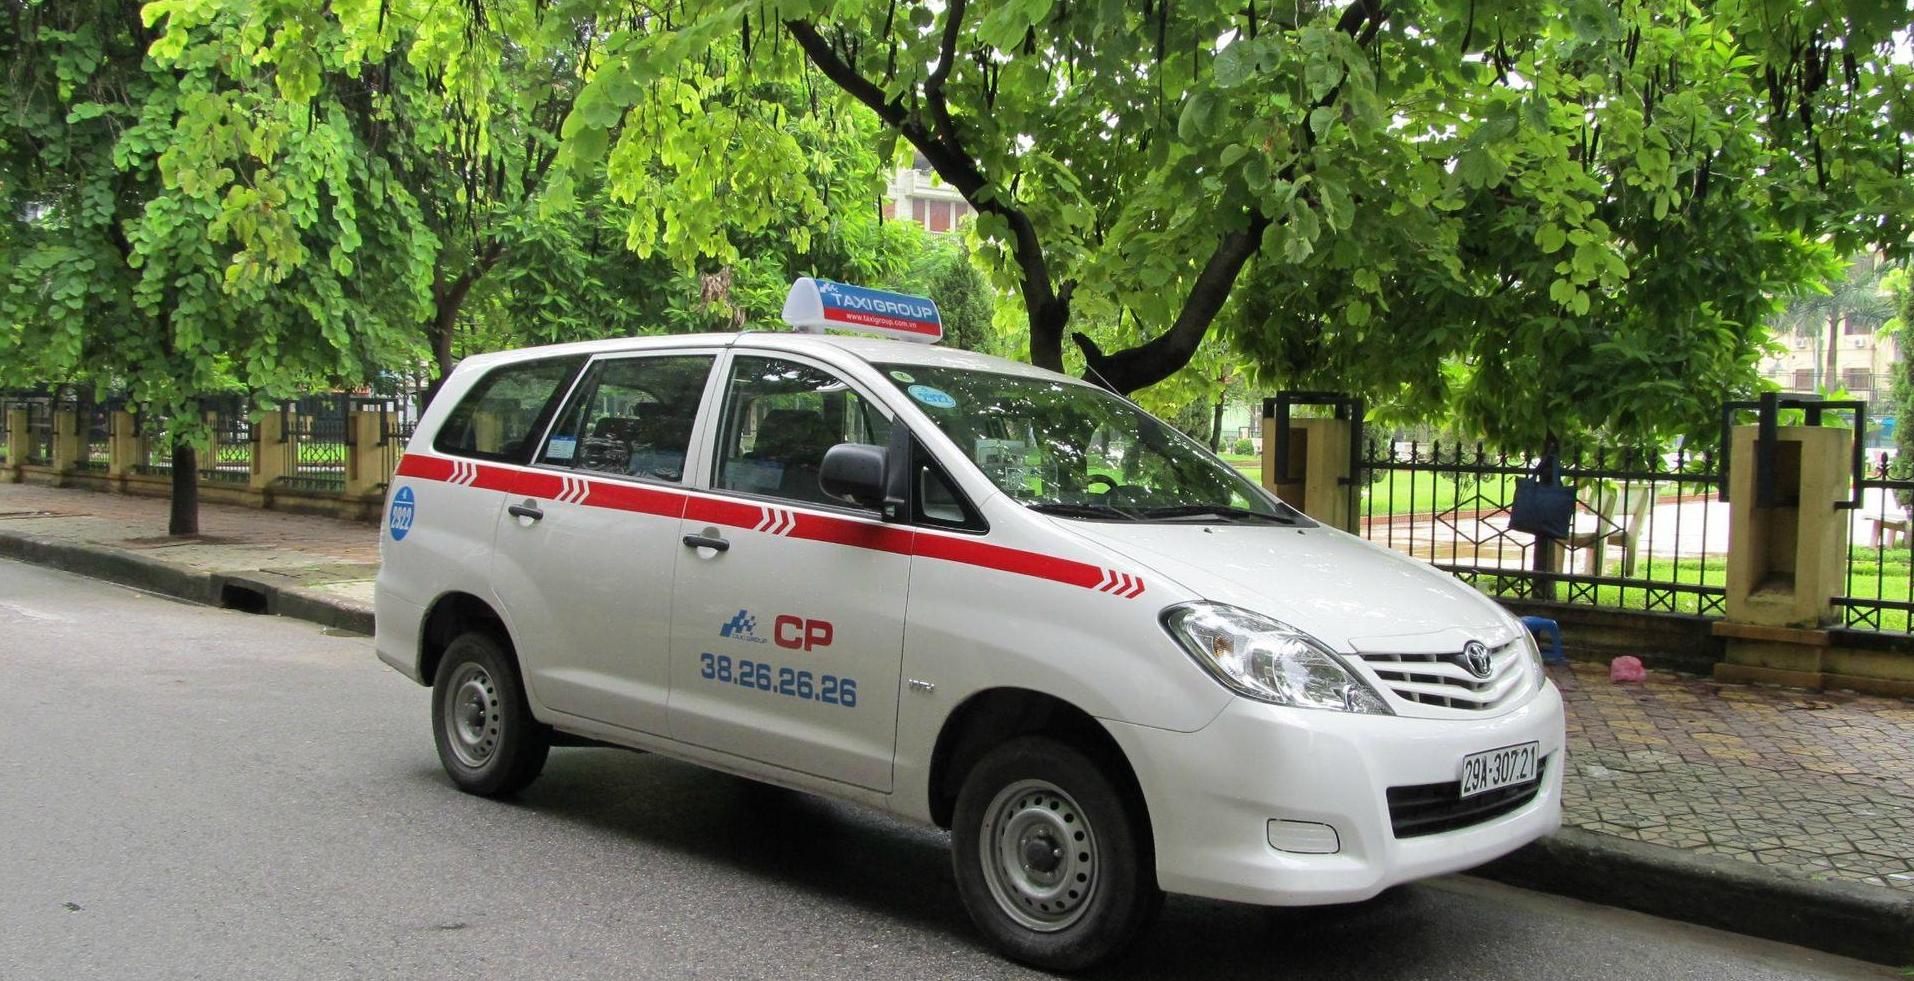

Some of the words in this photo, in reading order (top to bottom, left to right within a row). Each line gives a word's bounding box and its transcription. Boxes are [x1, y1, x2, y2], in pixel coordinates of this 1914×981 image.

[774, 614, 834, 652] CP
[700, 652, 857, 708] 38.26.26.26
[1463, 746, 1536, 793] 29A-307.21
